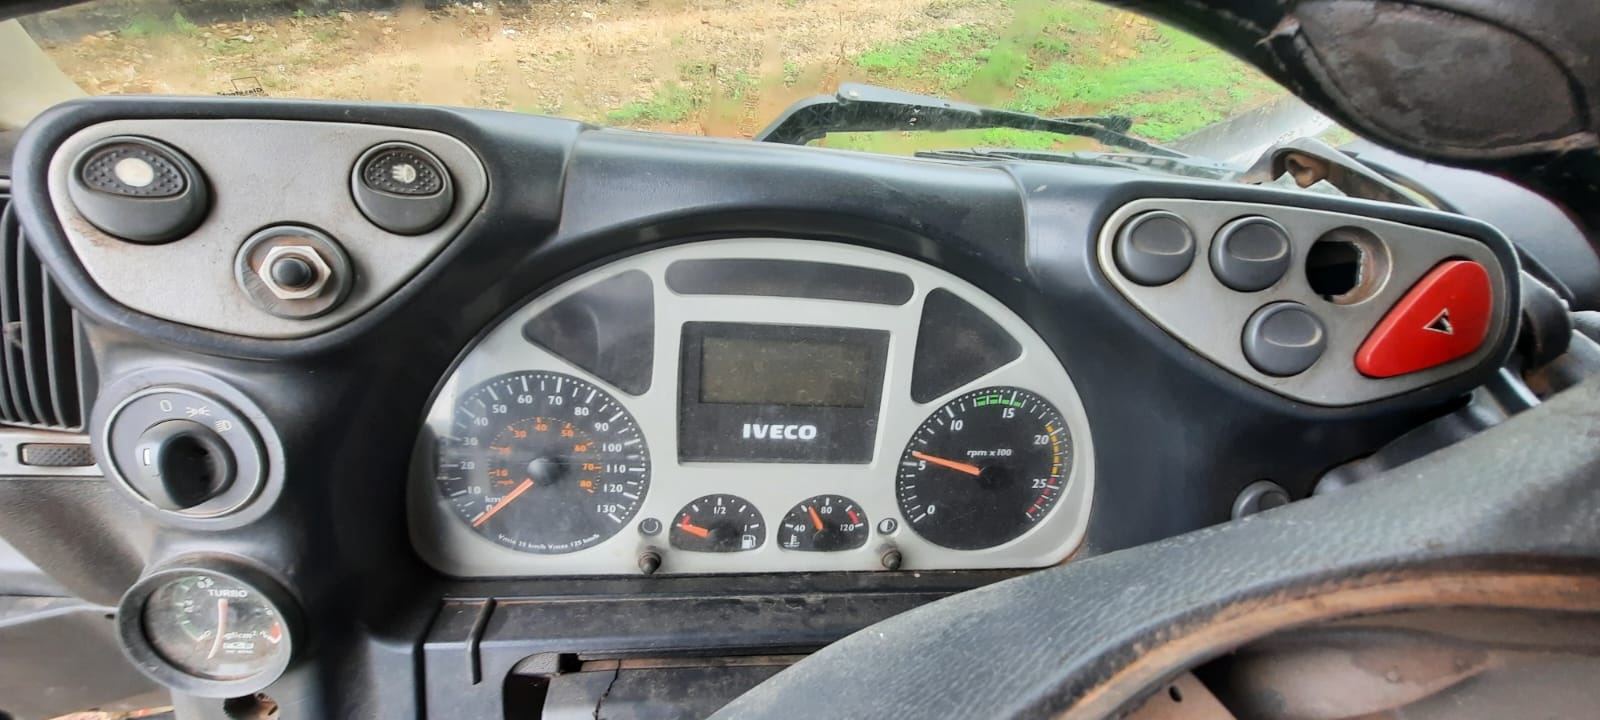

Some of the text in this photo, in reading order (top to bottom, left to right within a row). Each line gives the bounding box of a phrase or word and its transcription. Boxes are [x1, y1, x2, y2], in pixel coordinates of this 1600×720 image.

[517, 395, 533, 404] 60
[548, 396, 563, 405] 70
[492, 404, 507, 414] 50
[574, 407, 589, 416] 80
[1002, 408, 1015, 418] 15
[474, 417, 488, 426] 40
[950, 420, 963, 430] 10
[534, 423, 548, 431] 40
[594, 422, 609, 432] 90
[742, 423, 817, 440] IVECO
[514, 430, 527, 438] 30
[561, 429, 574, 437] 50
[463, 437, 478, 446] 30
[1034, 435, 1049, 445] 20
[602, 443, 622, 452] 100
[967, 450, 987, 458] rpm
[460, 461, 475, 470] 20
[582, 463, 594, 471] 70
[606, 464, 626, 473] 110
[918, 461, 926, 470] 5
[496, 469, 508, 477] 10
[580, 480, 592, 488] 80
[603, 484, 623, 493] 120
[1032, 479, 1047, 489] 25
[467, 486, 481, 494] 10
[597, 504, 616, 513] 130
[713, 506, 727, 514] 1/2
[820, 506, 833, 514] 80
[927, 504, 936, 515] 0
[793, 524, 806, 532] 40
[840, 524, 855, 532] 120
[208, 589, 248, 598] TURBO
